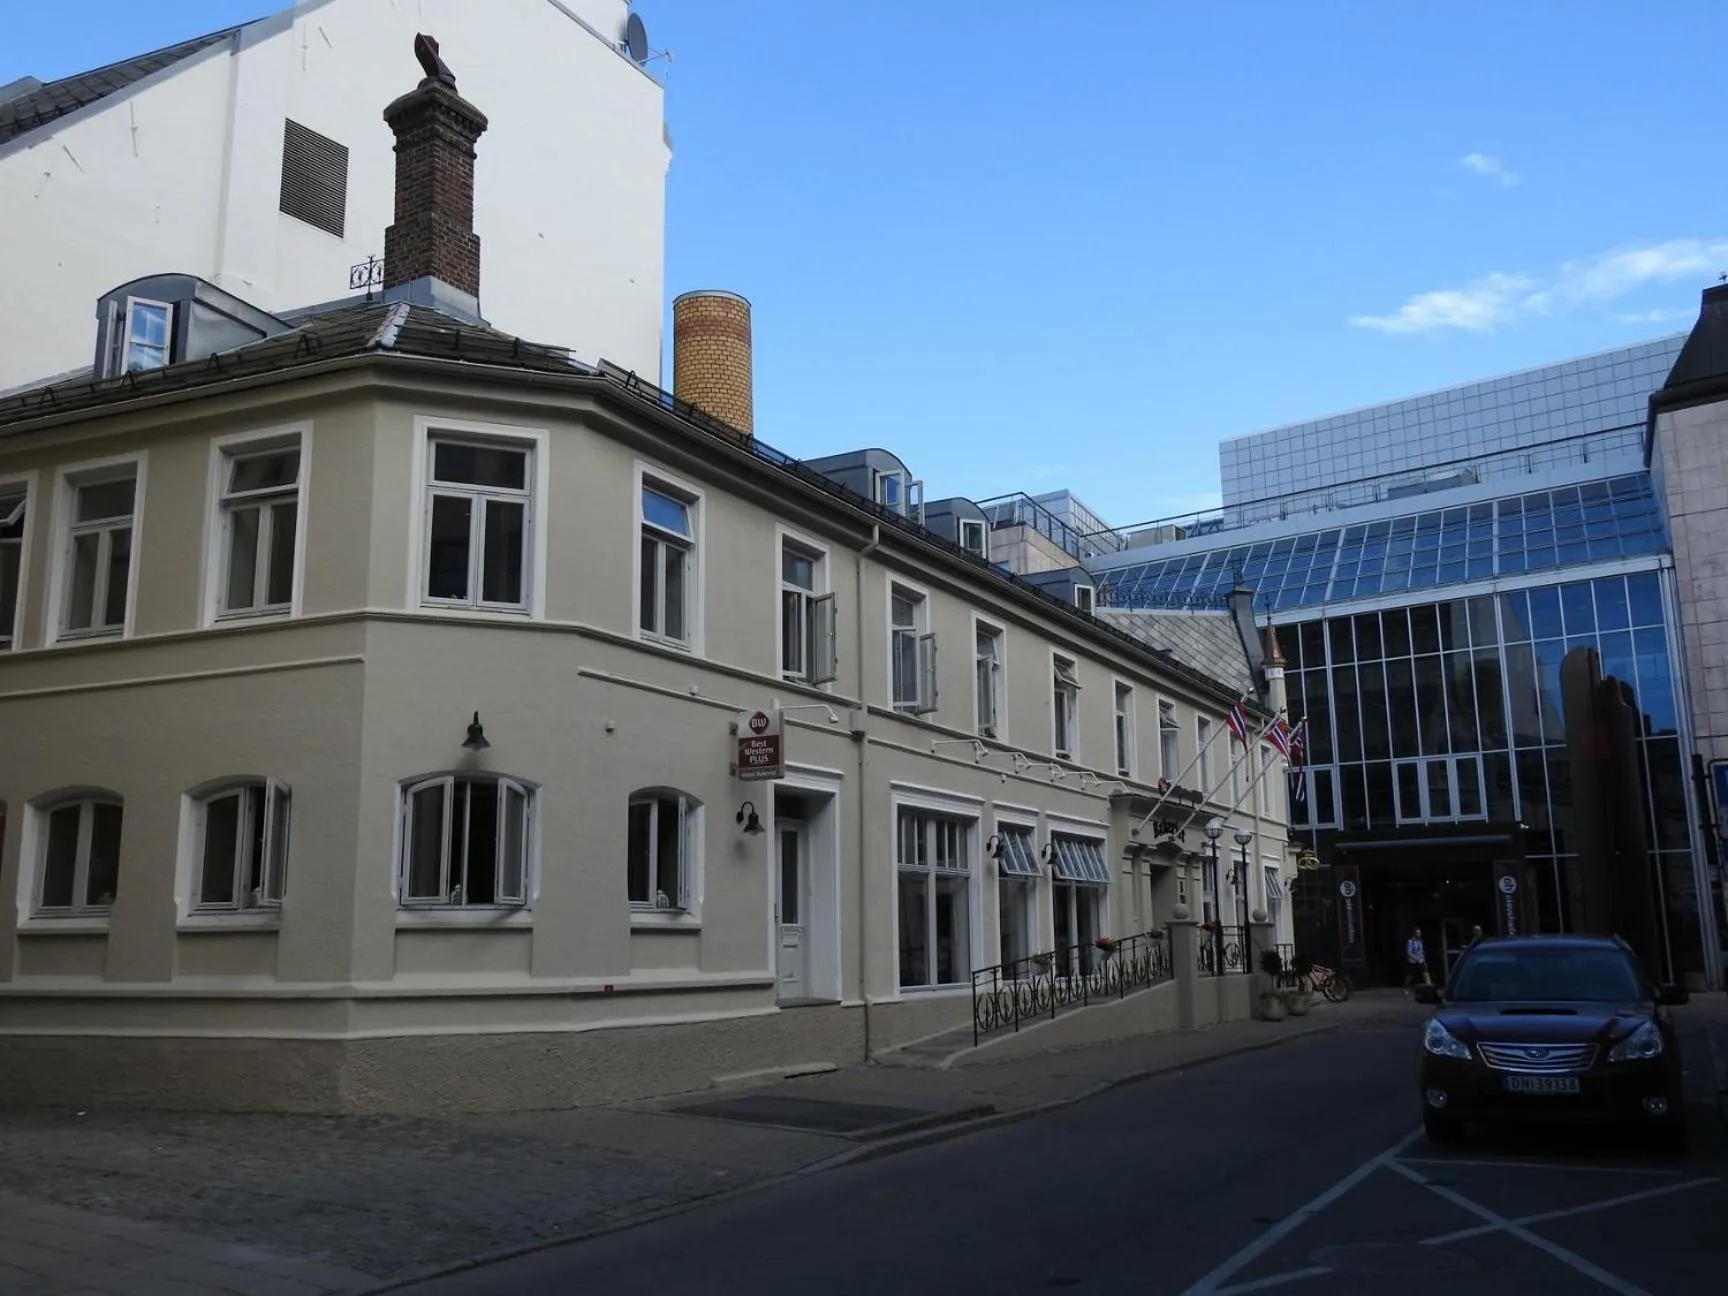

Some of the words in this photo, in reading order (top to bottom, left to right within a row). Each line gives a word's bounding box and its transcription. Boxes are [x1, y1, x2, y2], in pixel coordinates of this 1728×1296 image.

[751, 718, 767, 729] BW
[751, 740, 767, 748] Best
[744, 747, 774, 756] Western
[749, 755, 769, 764] PLUS
